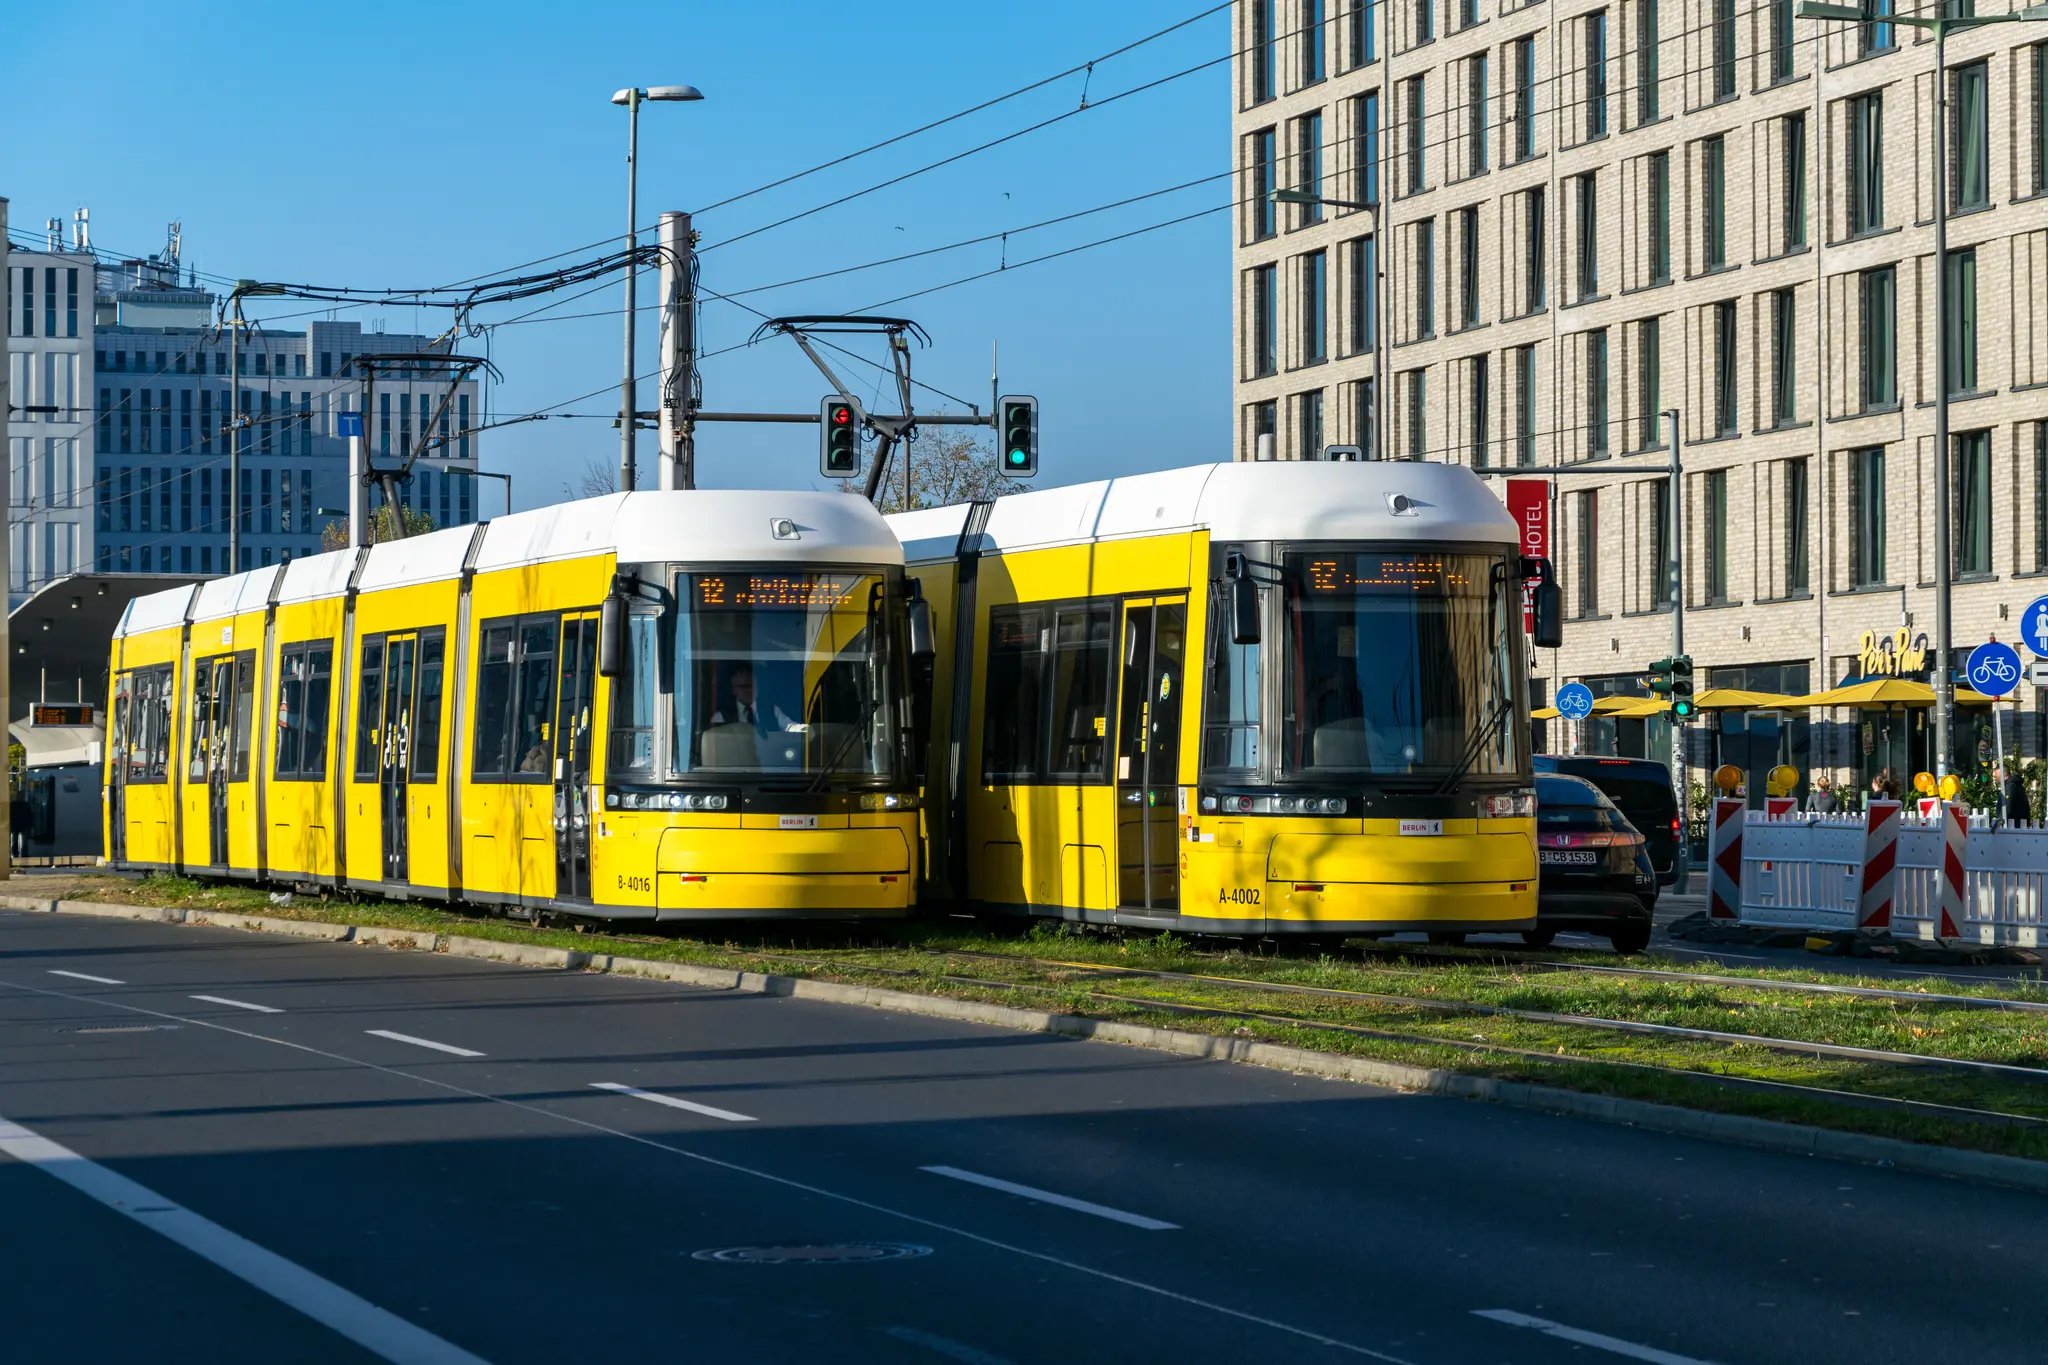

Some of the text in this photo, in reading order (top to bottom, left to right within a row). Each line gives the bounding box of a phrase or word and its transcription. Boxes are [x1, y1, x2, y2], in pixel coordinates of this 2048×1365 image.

[1526, 501, 1542, 557] HOTEL
[1857, 627, 1926, 680] Peter Pane
[1402, 824, 1427, 832] BERLIN
[618, 875, 651, 892] B-4016
[1219, 888, 1261, 905] A-4002
